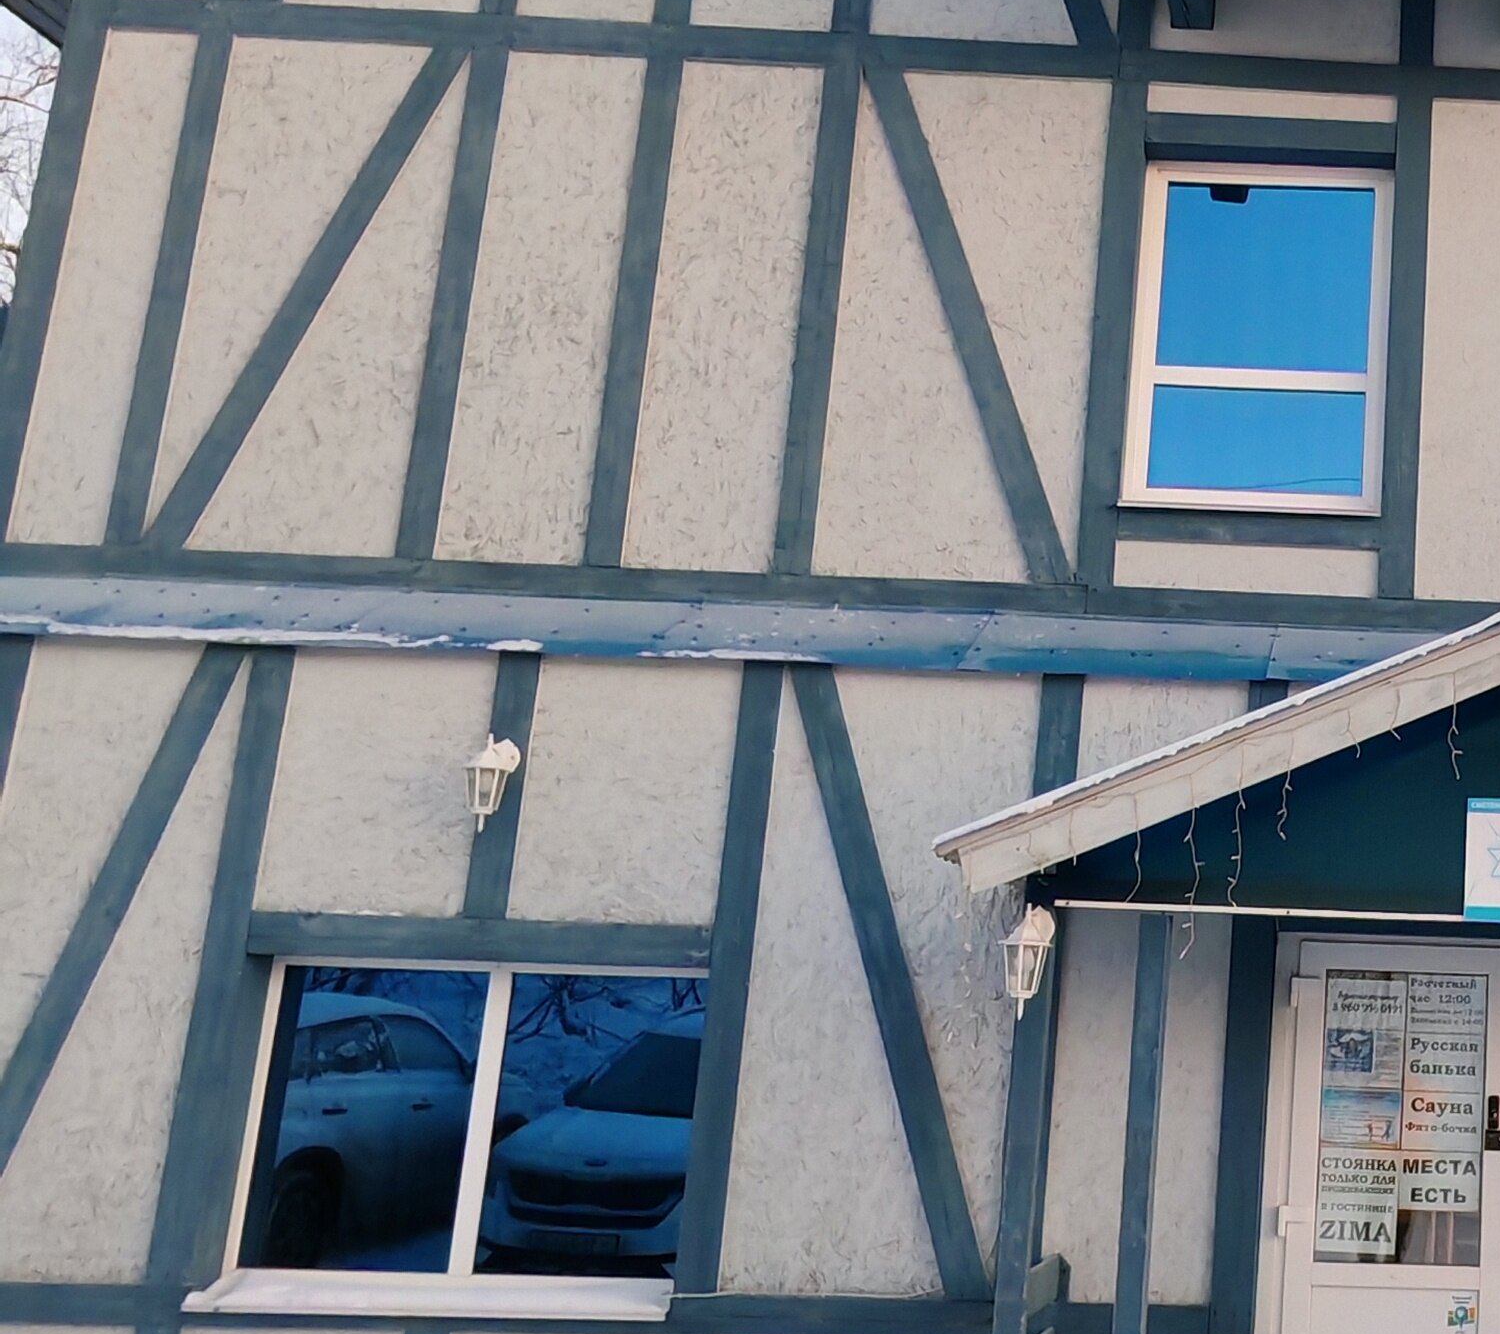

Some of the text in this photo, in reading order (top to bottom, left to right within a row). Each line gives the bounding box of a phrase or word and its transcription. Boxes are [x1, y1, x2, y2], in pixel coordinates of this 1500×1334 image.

[1409, 994, 1430, 1004] час
[1439, 994, 1472, 1004] 12:00
[1410, 1037, 1479, 1054] Русская
[1410, 1059, 1477, 1076] банька
[1411, 1097, 1474, 1117] Сауна
[1321, 1156, 1397, 1172] СТОЯНКА
[1403, 1158, 1477, 1176] МЕСТА
[1321, 1173, 1396, 1186] ТОЛЬКО ДЛЯ
[1411, 1187, 1467, 1204] ЕСТЬ
[1330, 1202, 1394, 1214] ГОСТИНИЦЕ
[1319, 1219, 1392, 1244] ZIMA
